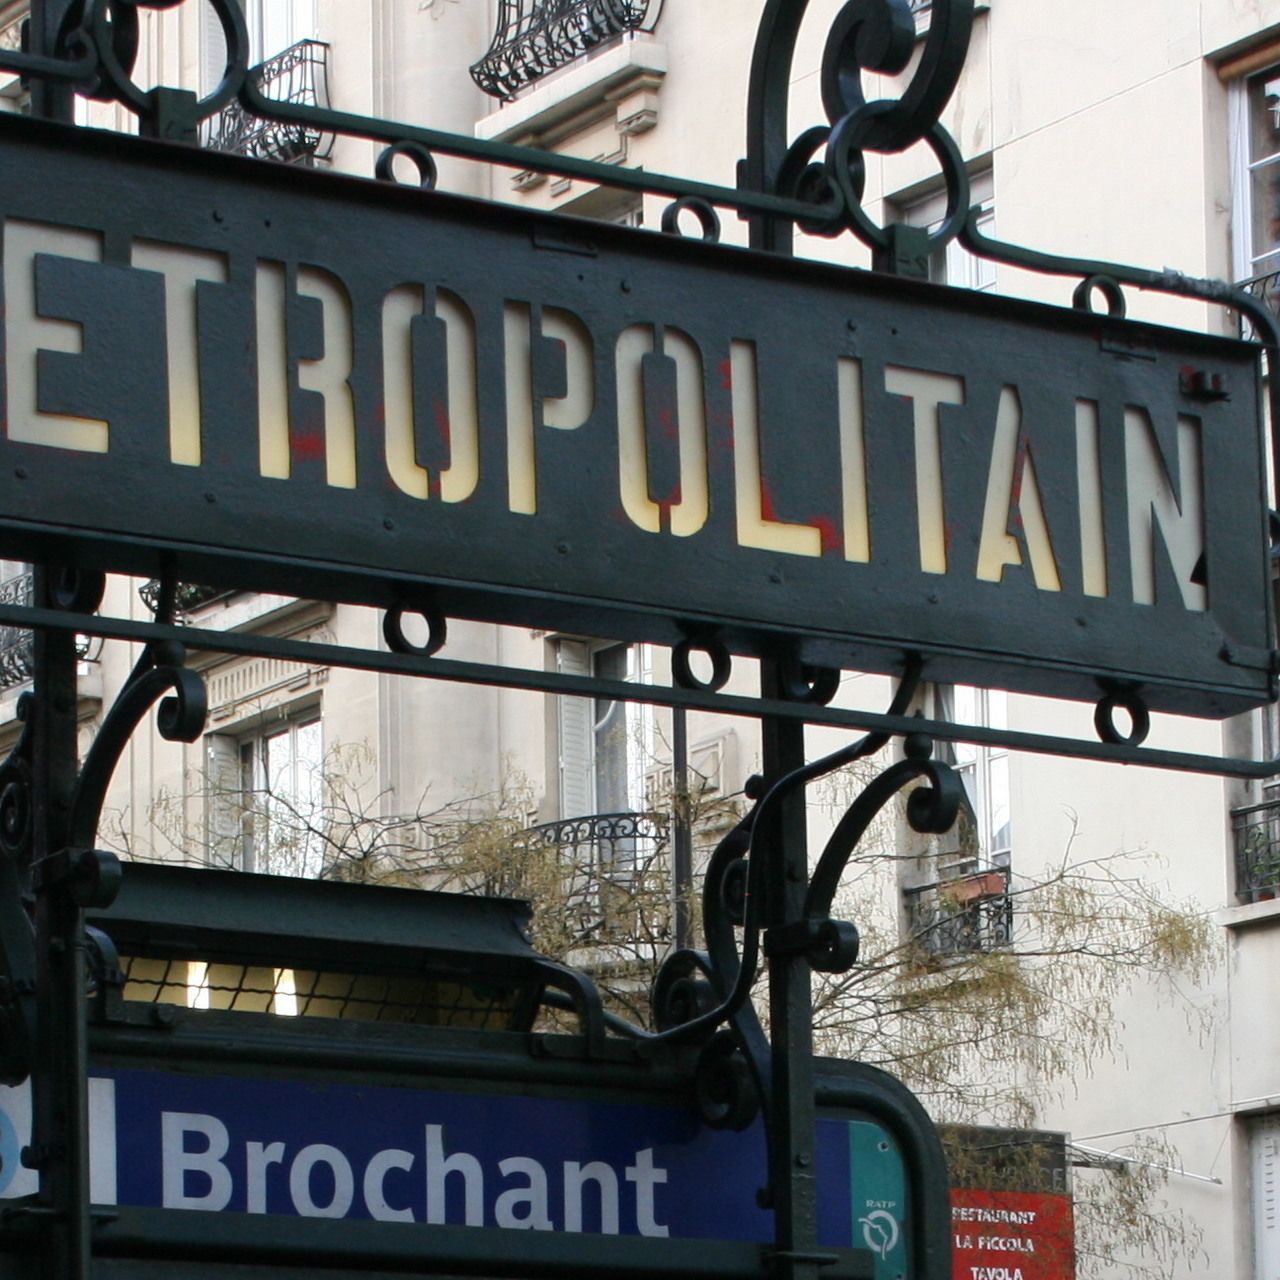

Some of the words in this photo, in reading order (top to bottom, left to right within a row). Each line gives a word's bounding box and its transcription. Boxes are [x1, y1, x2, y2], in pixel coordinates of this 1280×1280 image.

[161, 1111, 670, 1238] Brochant
[866, 1199, 897, 1209] RATP
[952, 1207, 1036, 1224] RESTAURANT
[955, 1234, 973, 1249] LA
[978, 1236, 1035, 1252] PICCOLA
